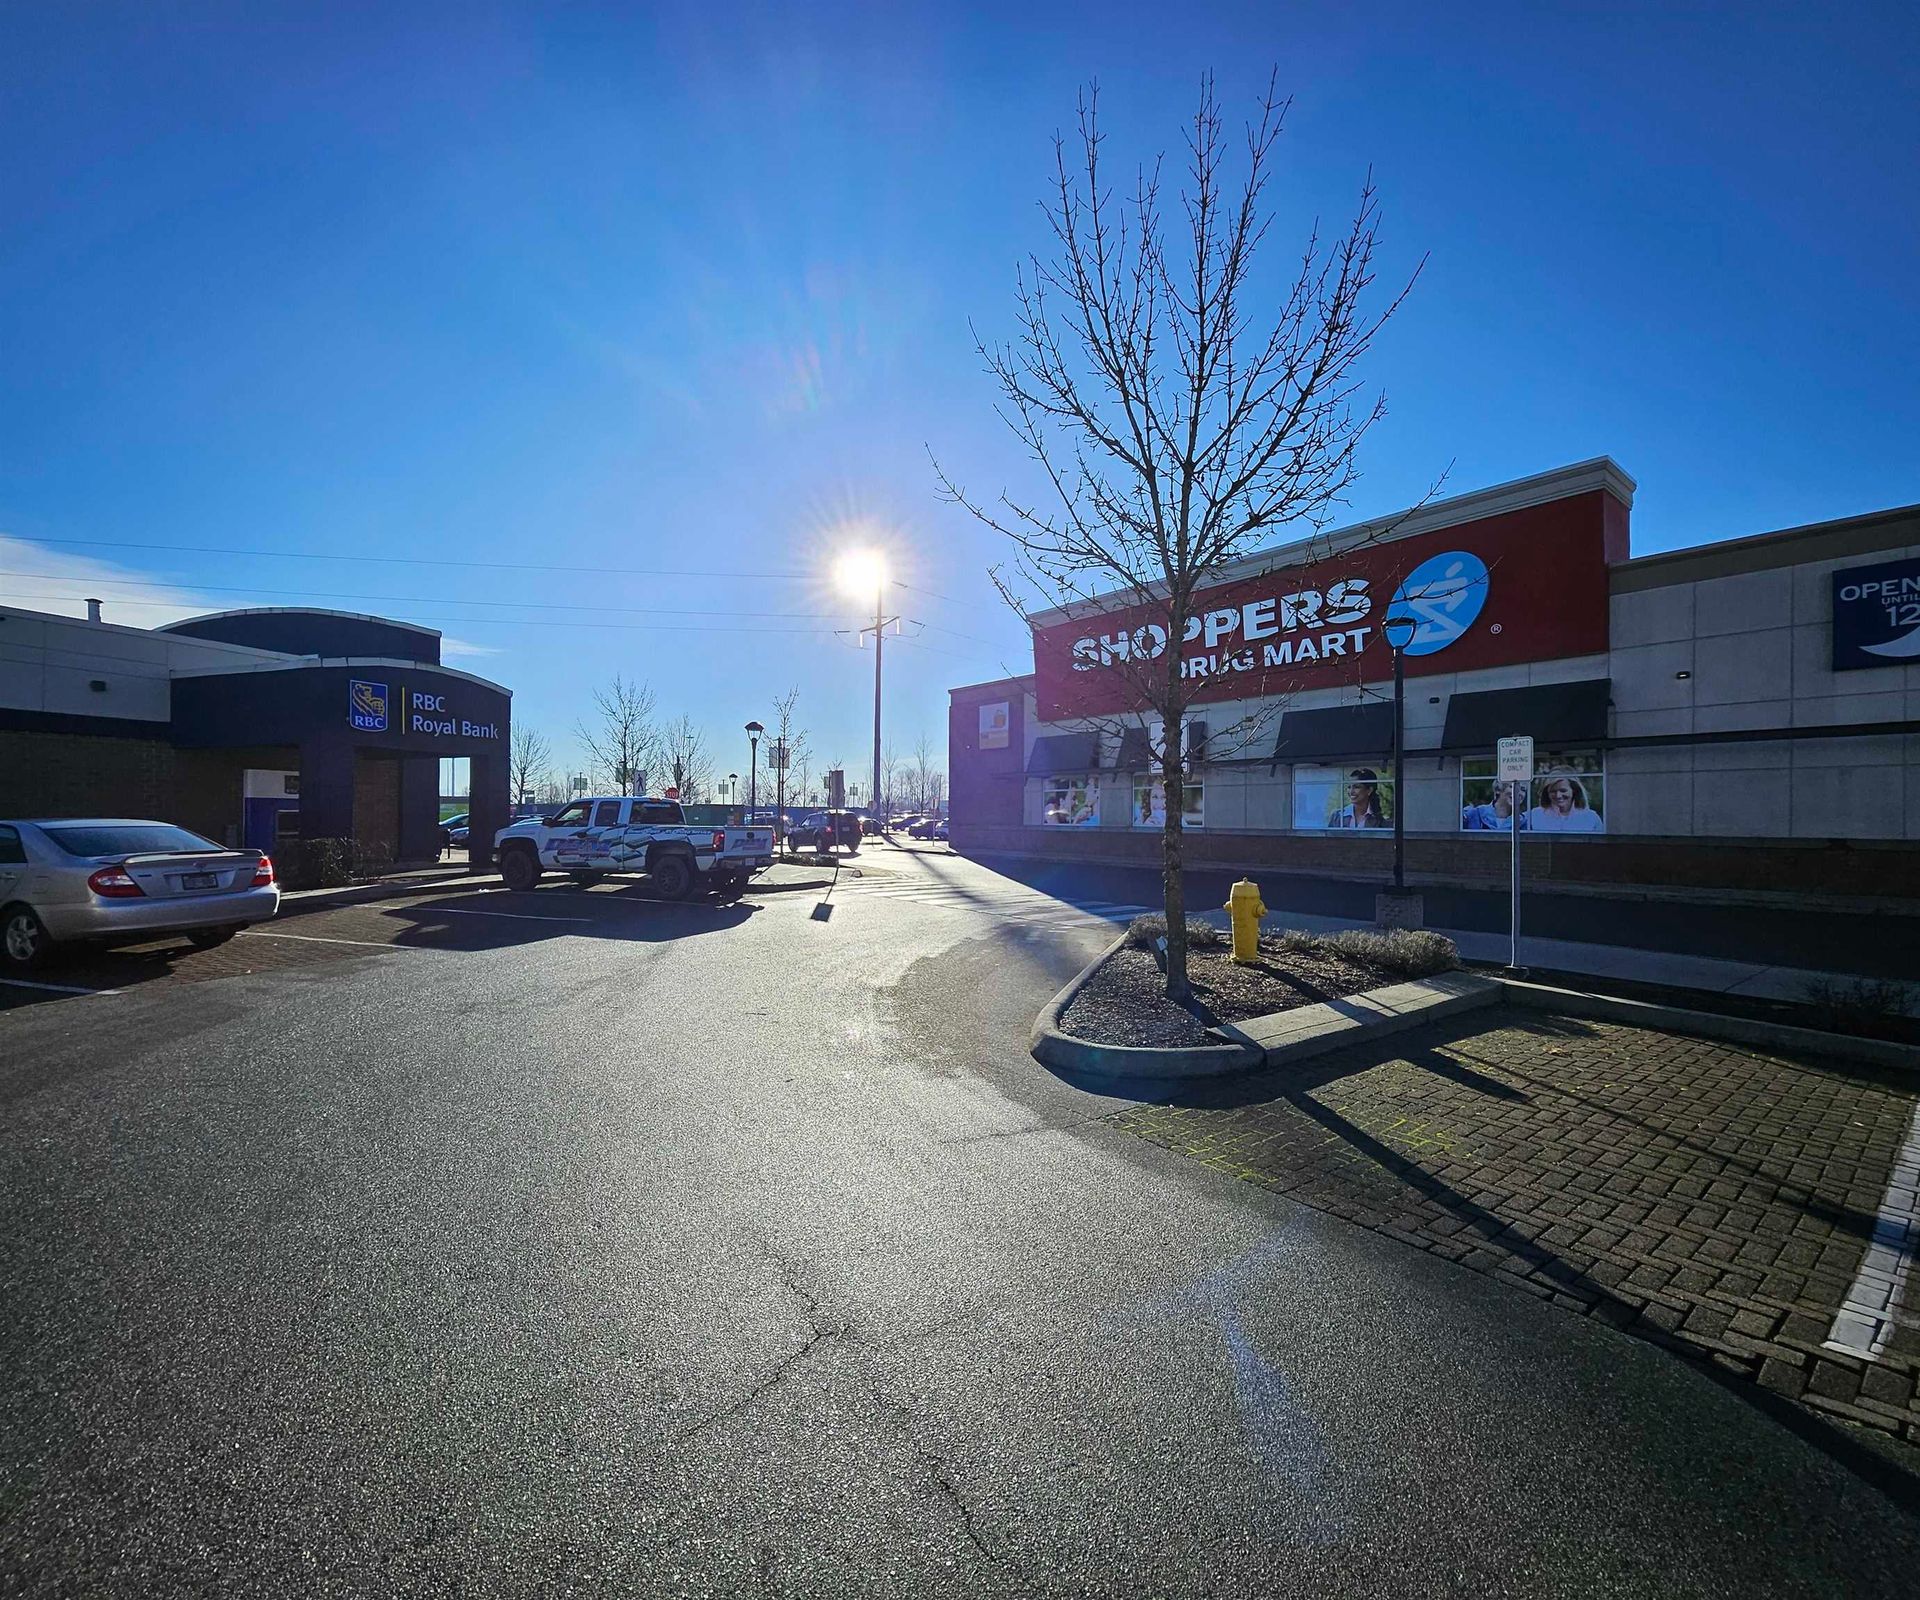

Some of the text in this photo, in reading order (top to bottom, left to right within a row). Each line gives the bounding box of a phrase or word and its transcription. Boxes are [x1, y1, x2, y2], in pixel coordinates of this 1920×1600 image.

[1839, 575, 1920, 601] OPEN
[1263, 626, 1372, 667] MART
[412, 692, 446, 713] RBC
[354, 714, 384, 728] RBC
[412, 714, 499, 740] Royal Bank
[1501, 740, 1529, 748] COMPACT
[666, 790, 679, 799] STOP
